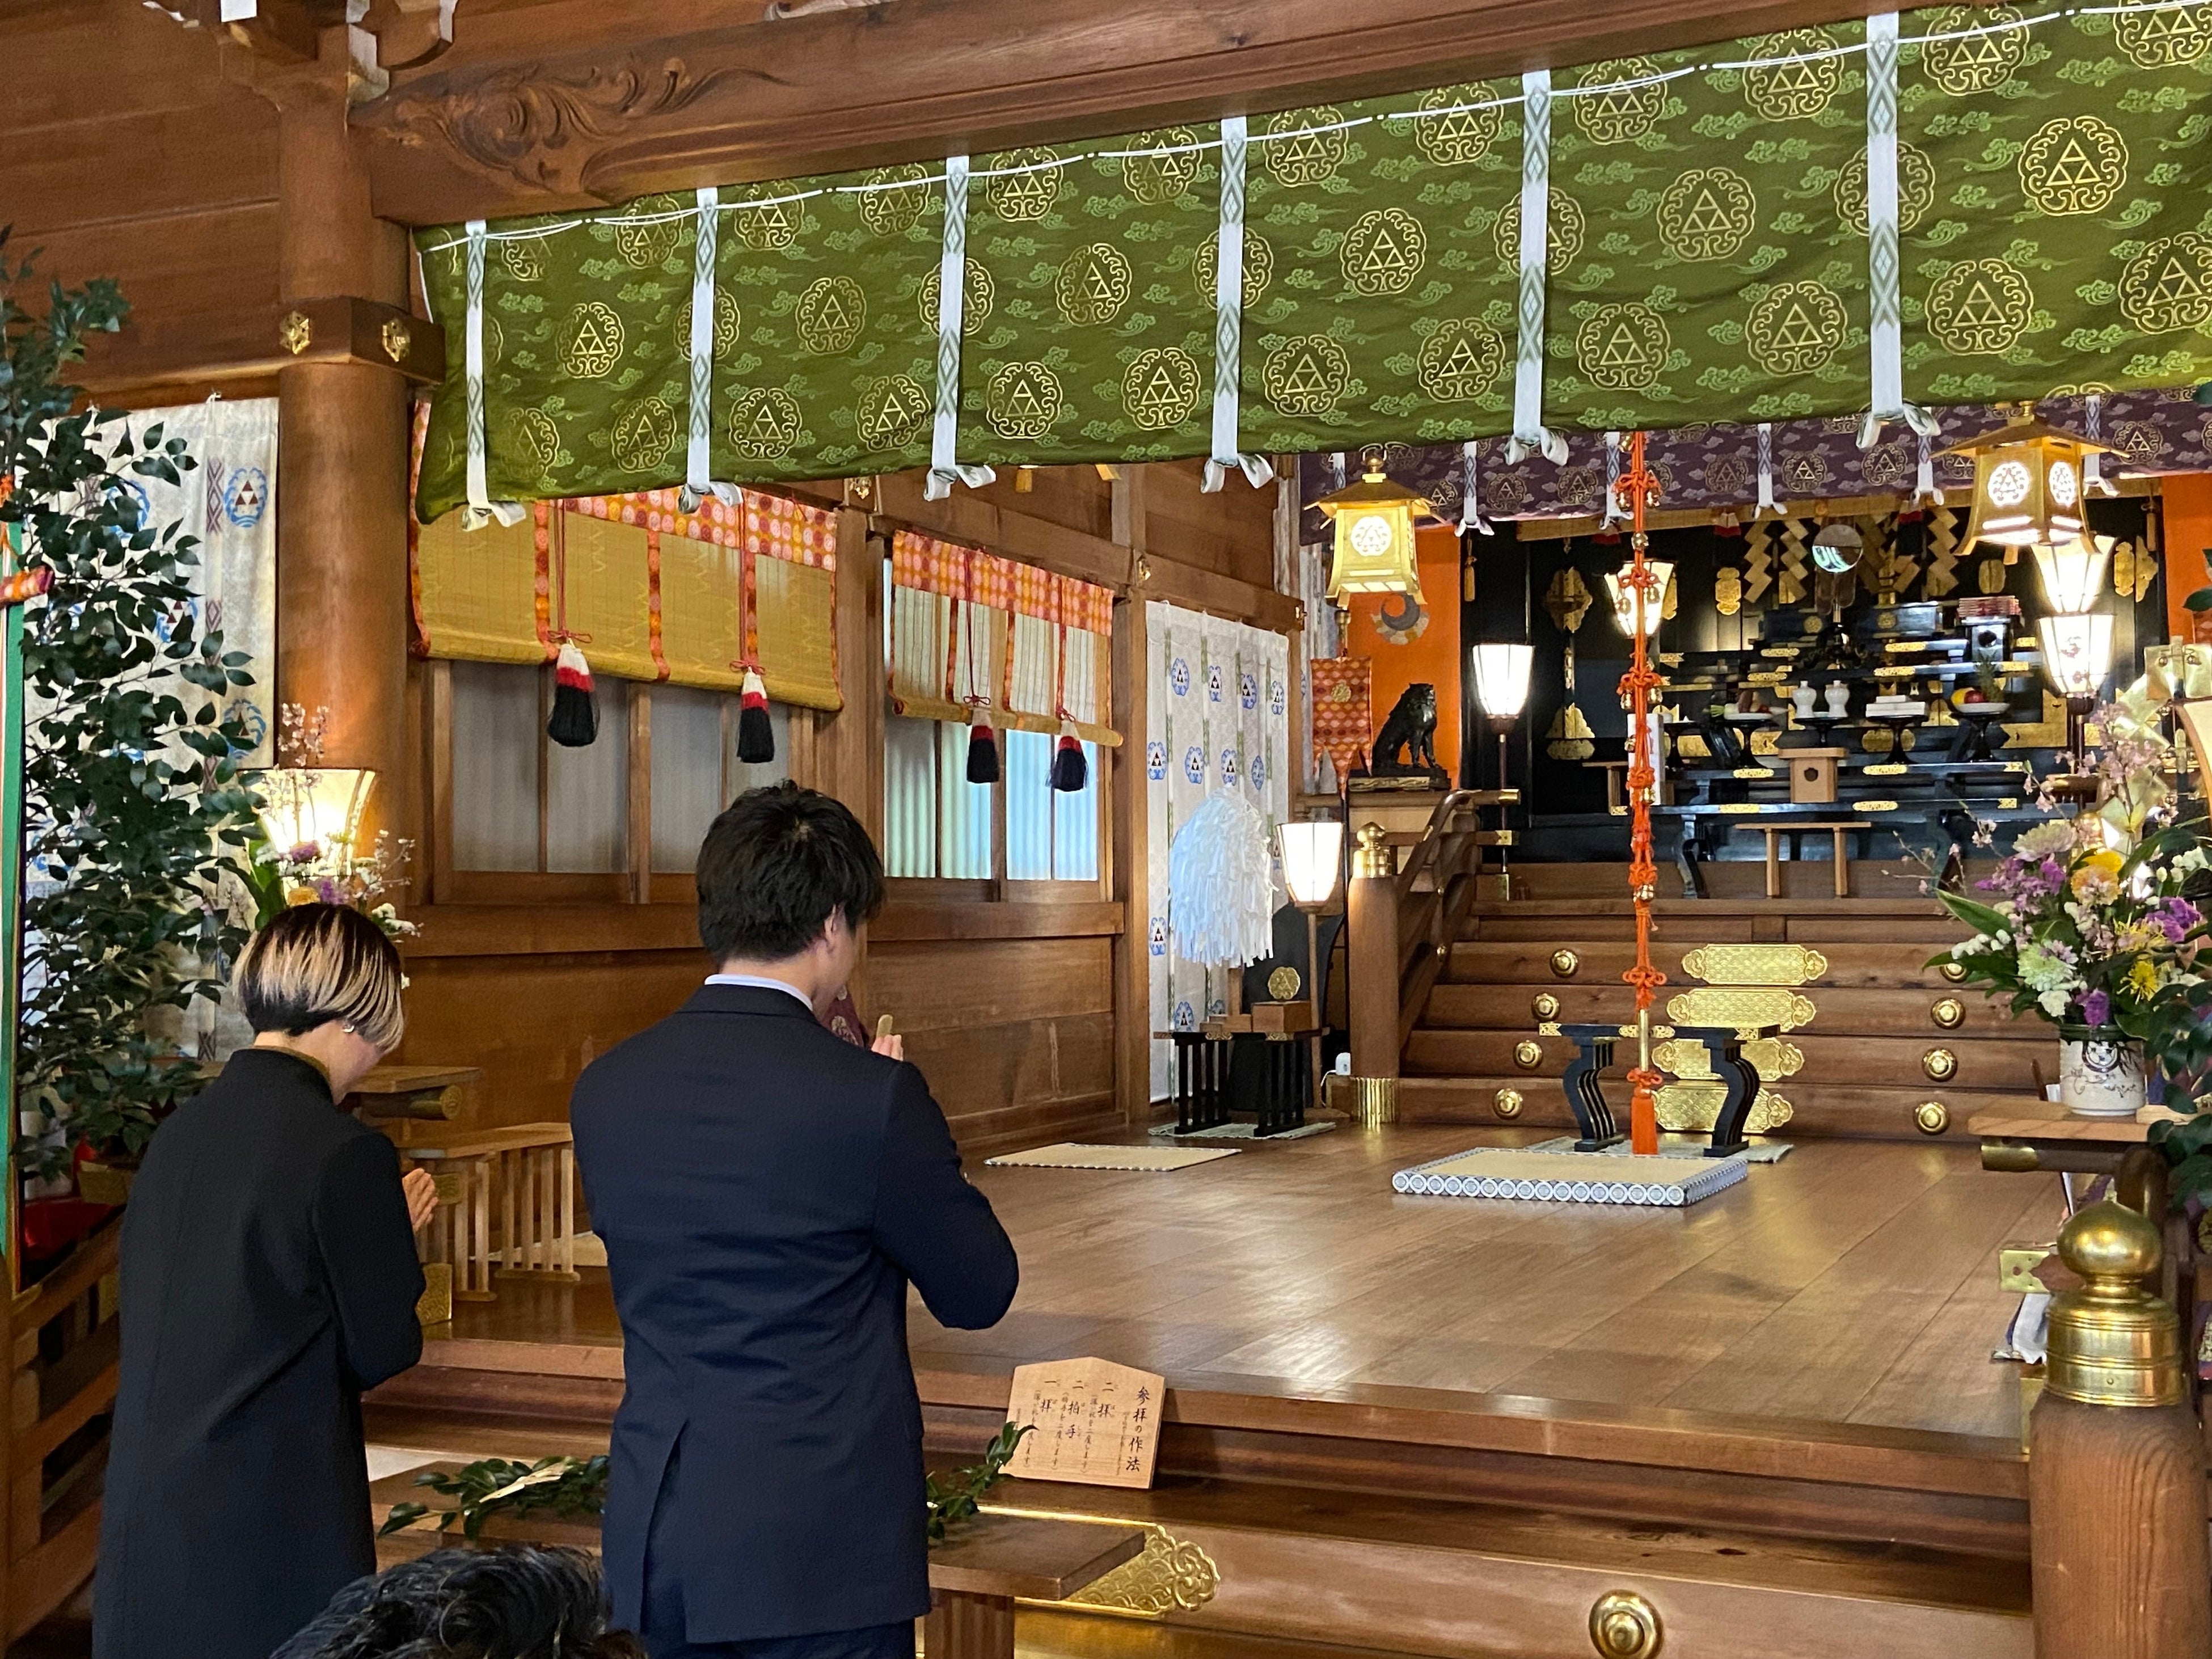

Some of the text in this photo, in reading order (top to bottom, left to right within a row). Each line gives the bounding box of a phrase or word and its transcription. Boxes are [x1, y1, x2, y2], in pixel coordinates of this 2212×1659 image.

[1126, 1386, 1150, 1472] 参拝の作法
